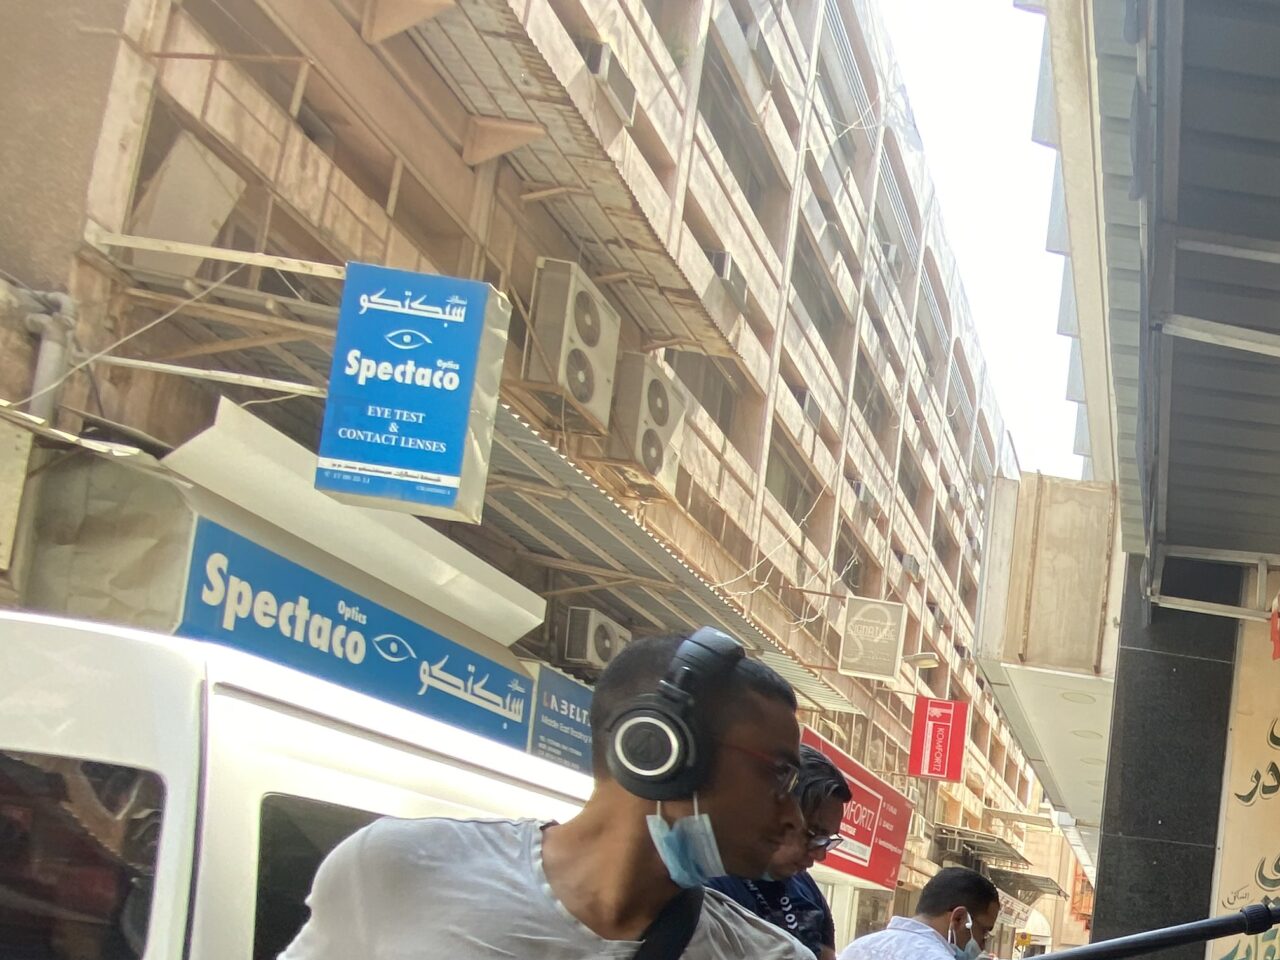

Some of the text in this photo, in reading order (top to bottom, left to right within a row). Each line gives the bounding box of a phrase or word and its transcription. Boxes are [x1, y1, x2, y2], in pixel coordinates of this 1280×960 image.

[359, 288, 466, 328] سبكتكو
[344, 349, 460, 391] Spectaco
[436, 359, 460, 370] Optics
[367, 405, 426, 424] EYE TEST
[388, 422, 400, 433] &
[338, 427, 447, 454] CONTACT LENSES
[201, 552, 367, 665] Spectaco
[337, 599, 367, 625] Optics
[417, 655, 525, 730] سبكتكو
[932, 727, 945, 772] KOMFORTZ
[843, 800, 875, 831] MFORTZ
